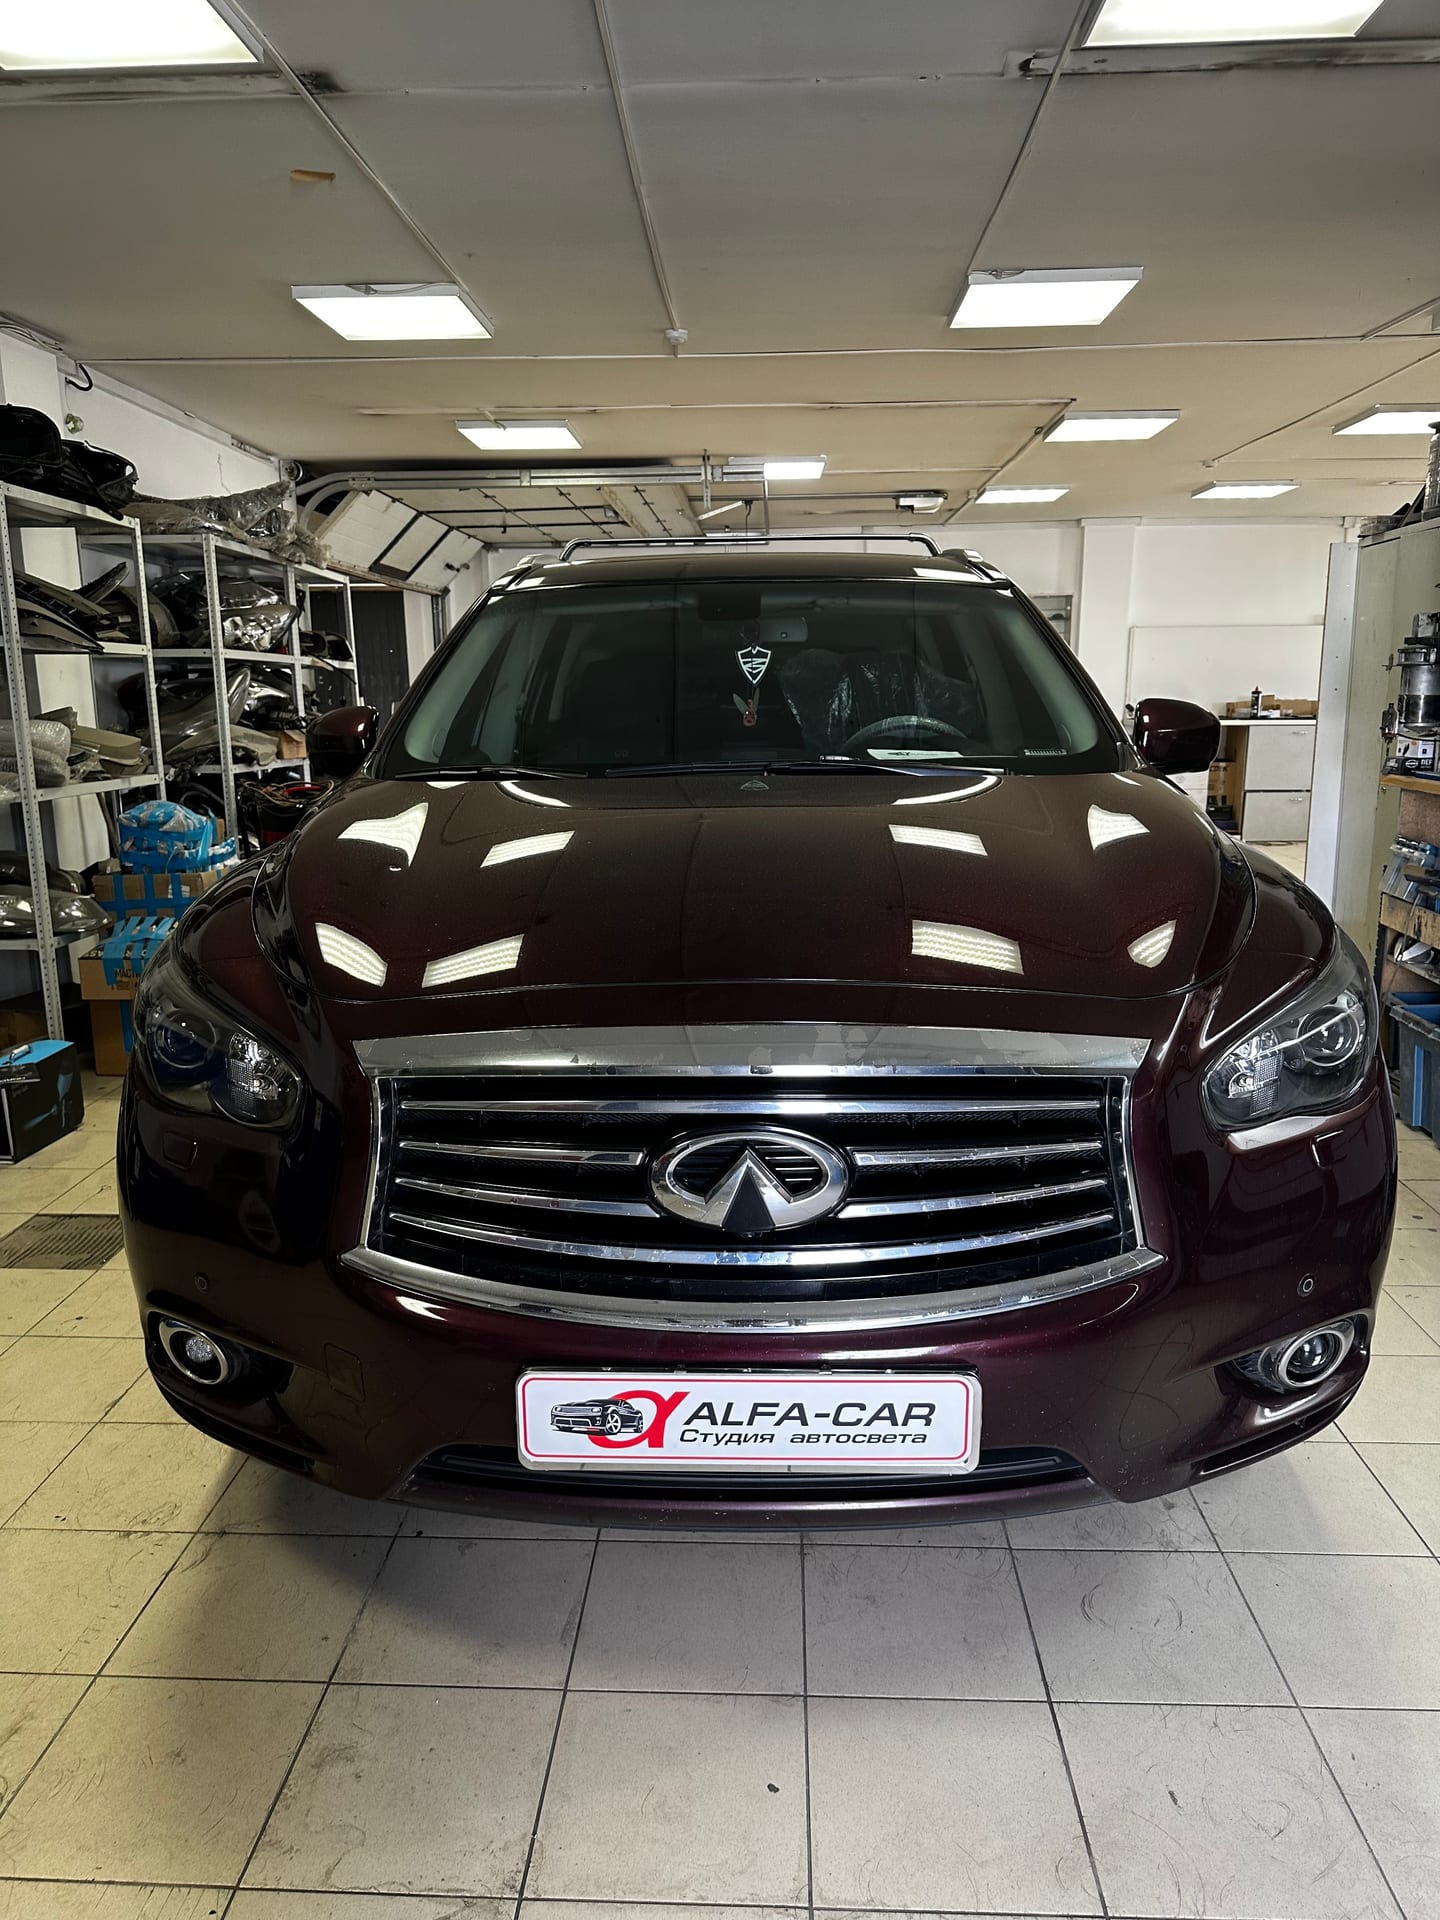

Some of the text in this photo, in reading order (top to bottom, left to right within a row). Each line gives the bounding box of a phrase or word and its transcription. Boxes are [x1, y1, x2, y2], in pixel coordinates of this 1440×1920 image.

[683, 1402, 936, 1427] ALFA-CAR
[679, 1429, 928, 1446] Студия автосвета
